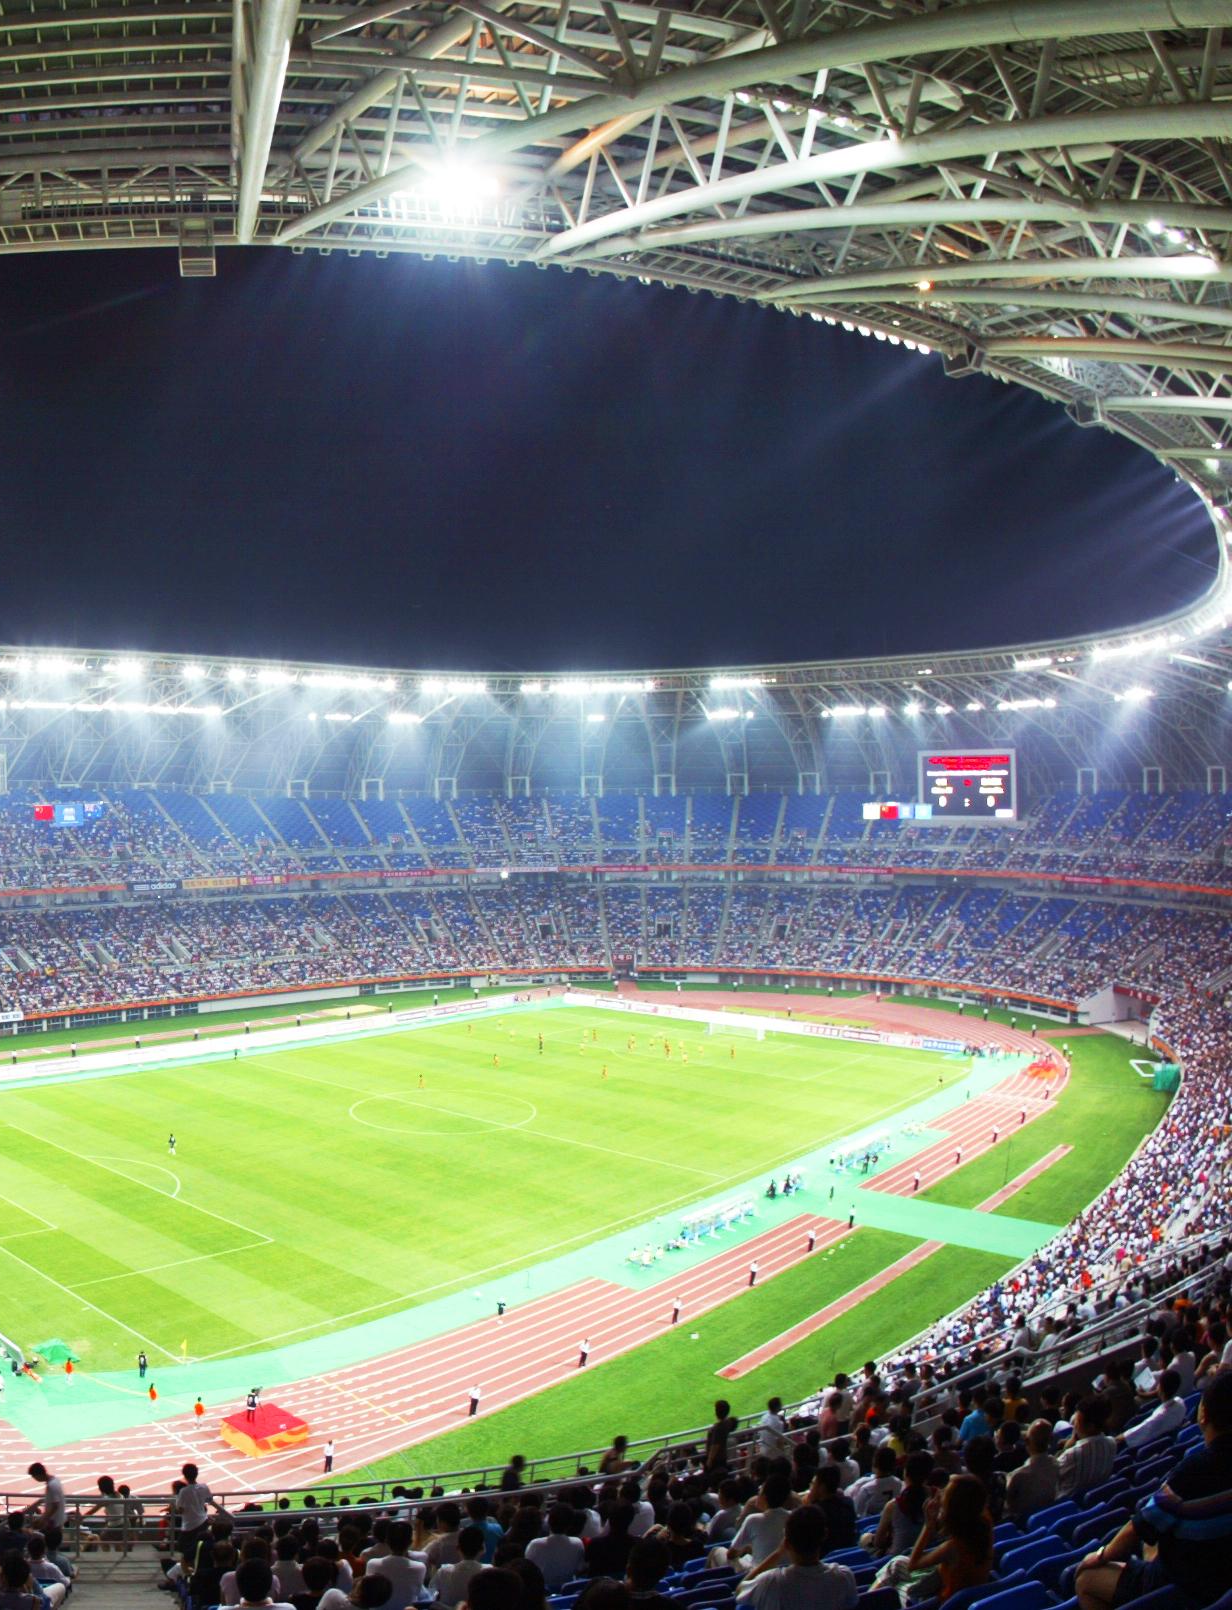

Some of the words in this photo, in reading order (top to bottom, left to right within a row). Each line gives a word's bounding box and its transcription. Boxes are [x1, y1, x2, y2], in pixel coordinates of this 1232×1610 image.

[938, 795, 947, 808] 0
[986, 795, 996, 808] 0
[151, 882, 177, 890] adidas
